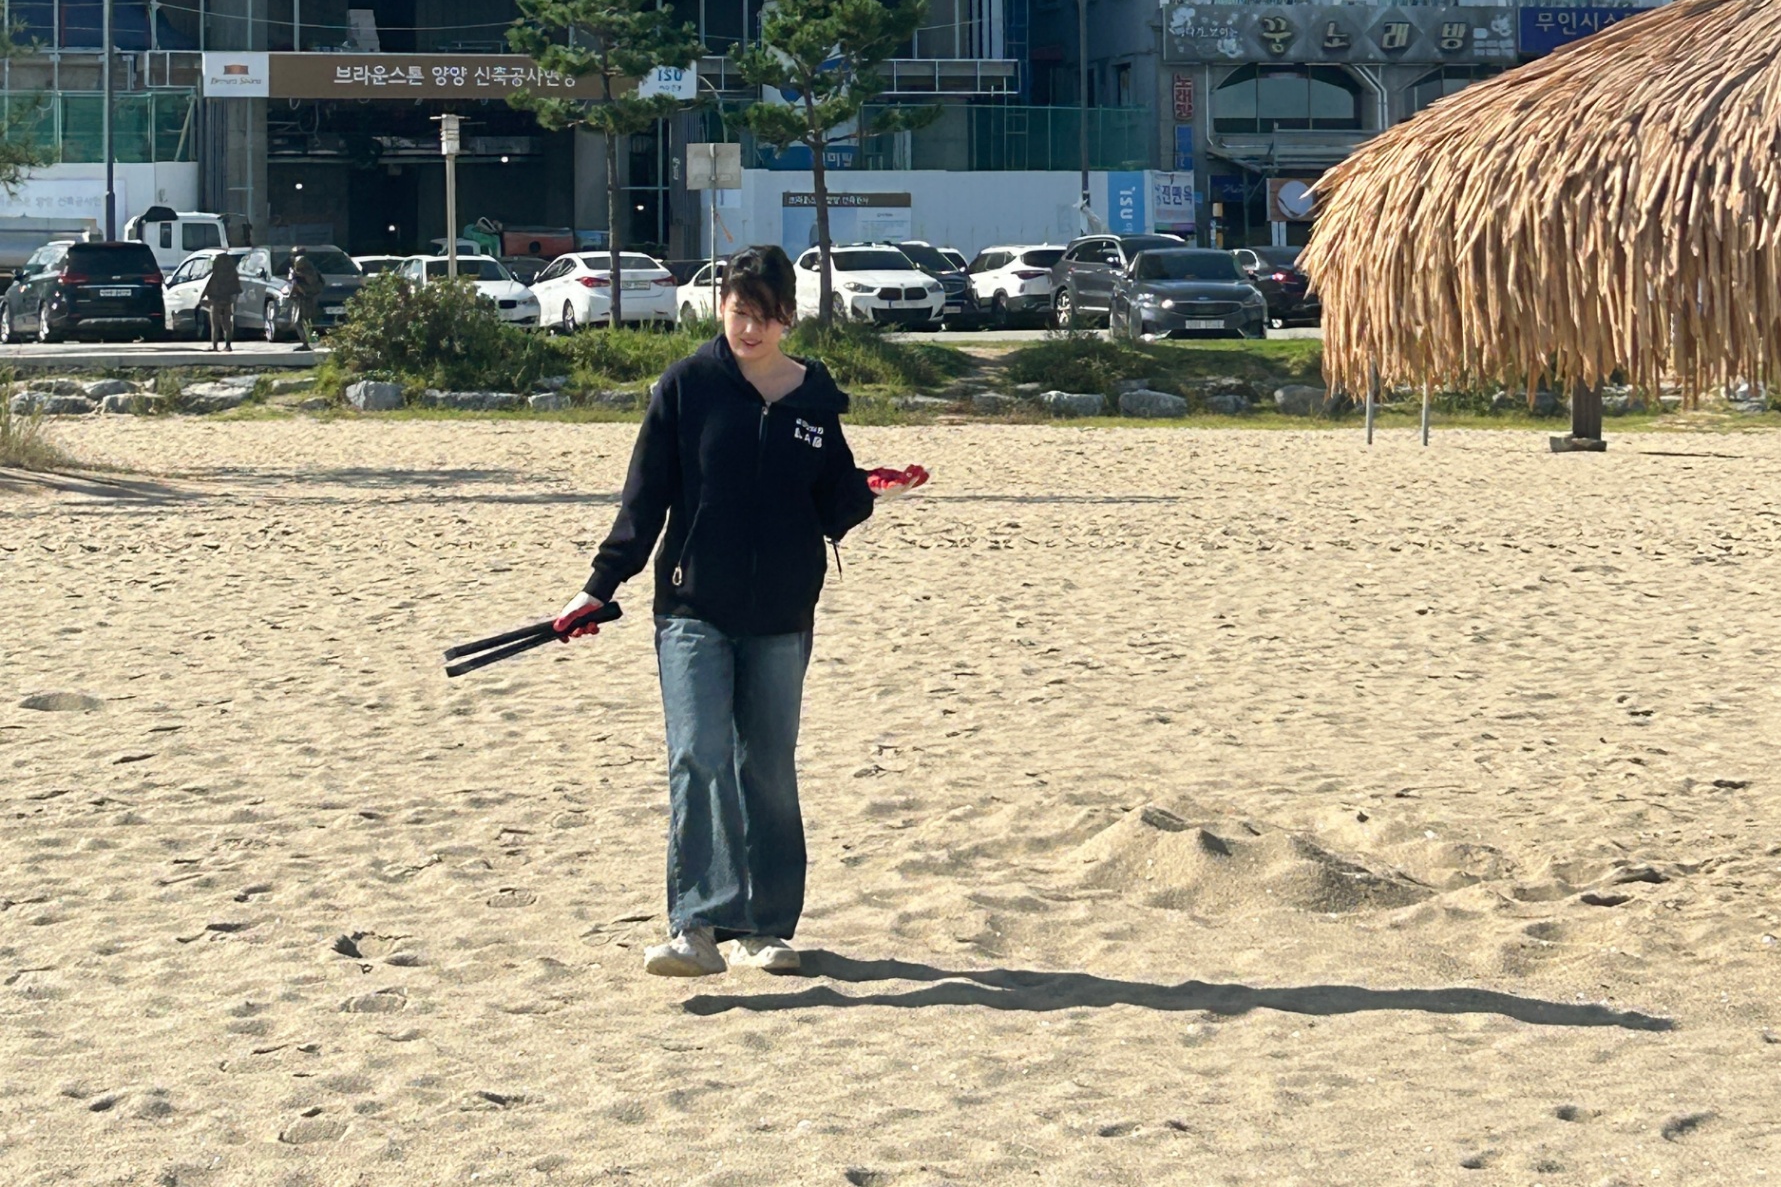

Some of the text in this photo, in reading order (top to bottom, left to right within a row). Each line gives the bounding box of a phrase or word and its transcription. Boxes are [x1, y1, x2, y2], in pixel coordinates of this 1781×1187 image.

[334, 65, 425, 86] 브라운스톤
[432, 66, 468, 87] 양양
[657, 69, 683, 82] ISU
[1120, 187, 1135, 220] ISU
[794, 427, 823, 449] LAB
